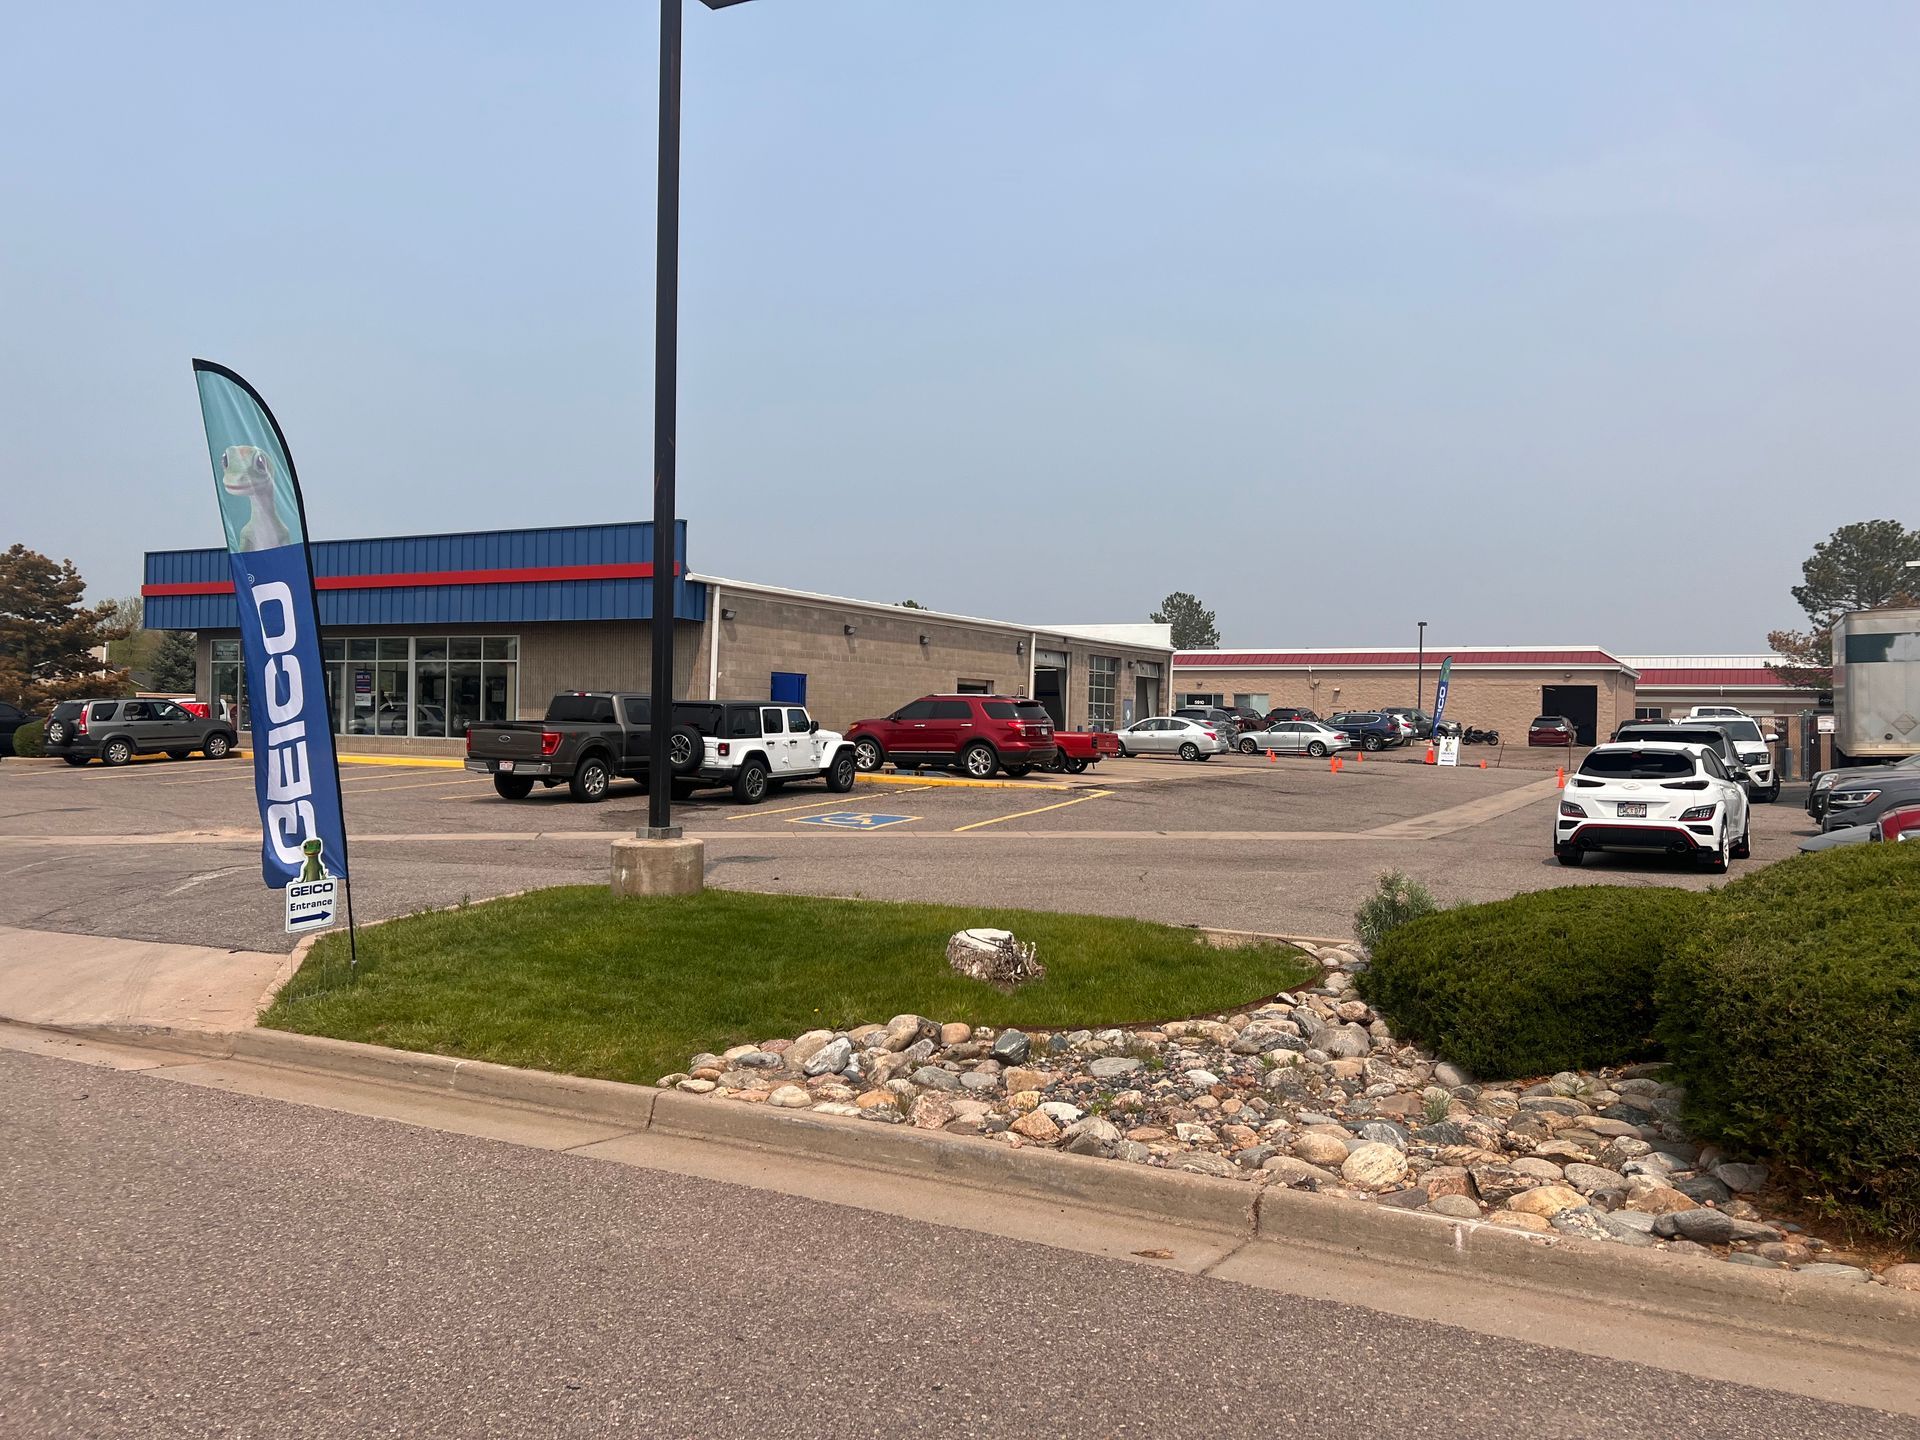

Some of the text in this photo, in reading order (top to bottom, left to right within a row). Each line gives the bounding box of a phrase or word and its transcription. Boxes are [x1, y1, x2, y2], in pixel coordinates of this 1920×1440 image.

[251, 581, 317, 864] GEICO
[290, 882, 334, 897] GEICO
[290, 898, 333, 911] Entrance
